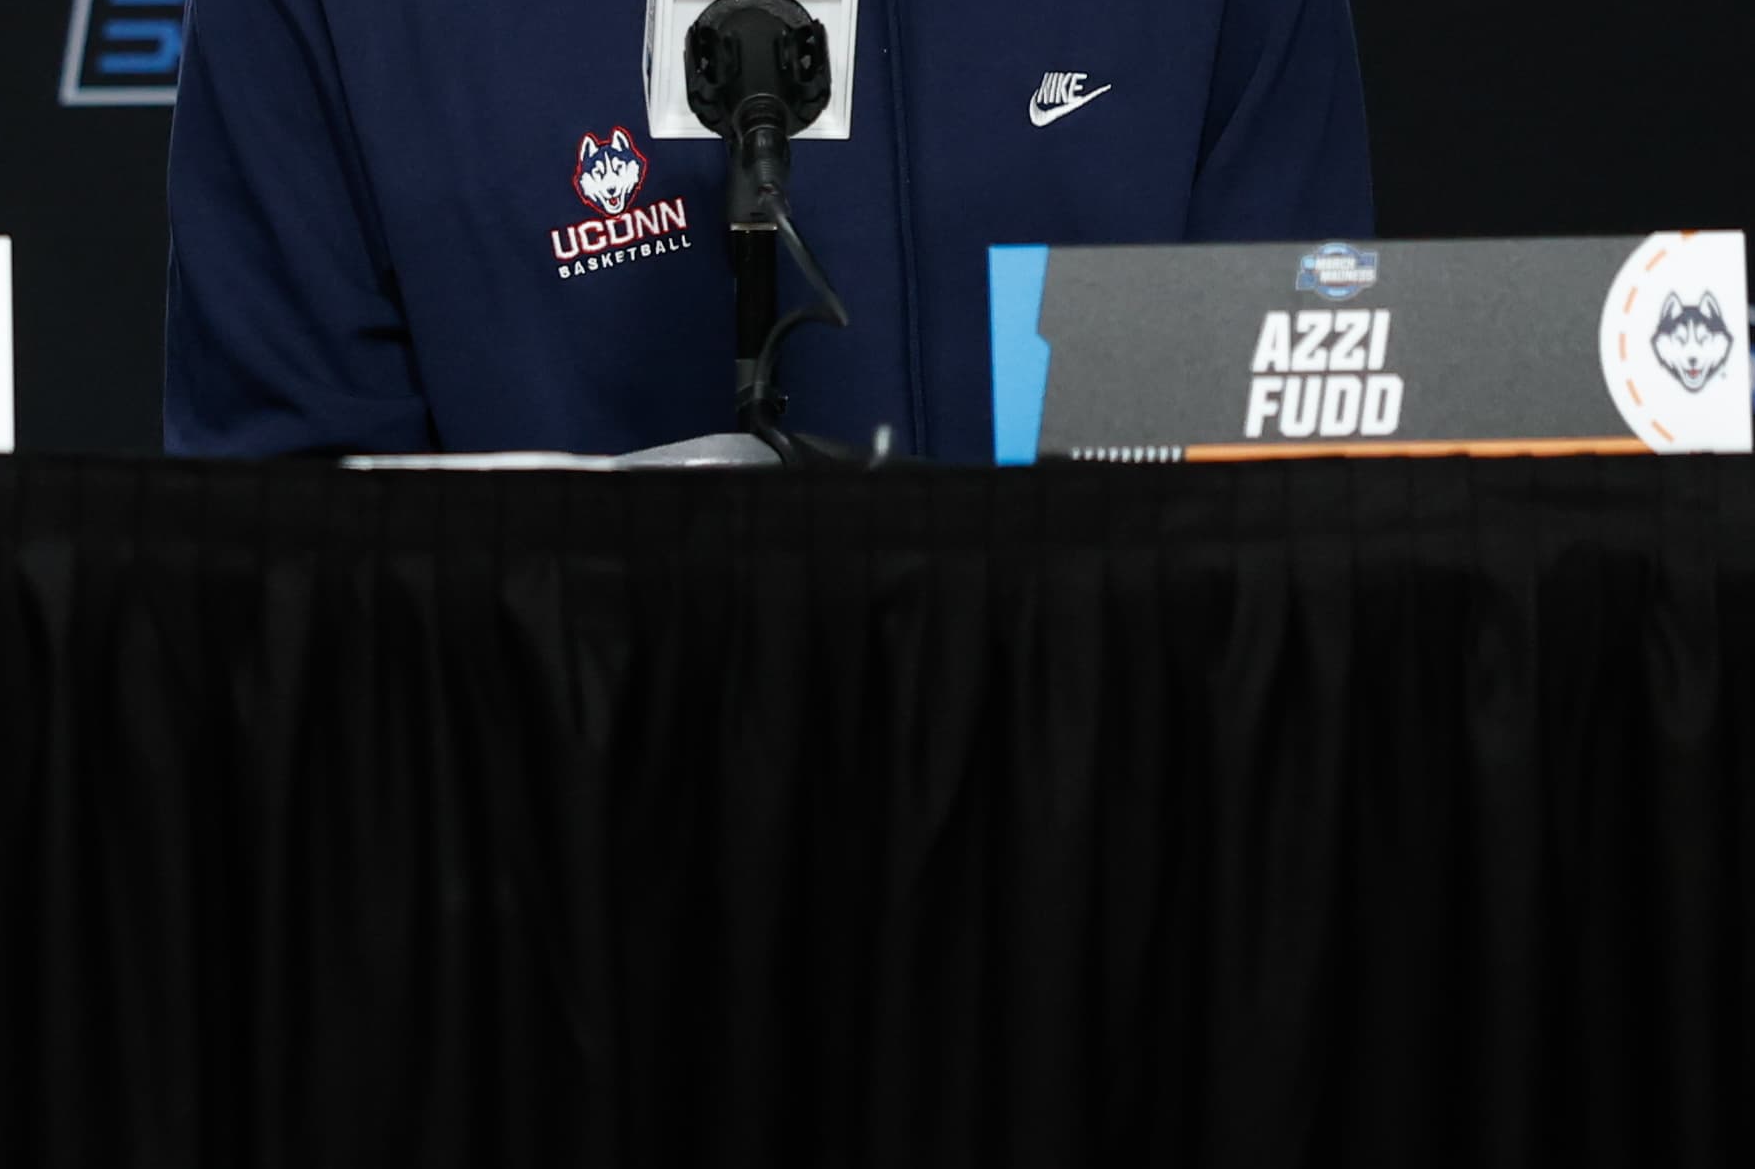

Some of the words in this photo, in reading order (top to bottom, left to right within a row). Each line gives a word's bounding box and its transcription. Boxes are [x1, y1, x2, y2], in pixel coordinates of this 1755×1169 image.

[1036, 71, 1088, 105] NIKE
[550, 197, 688, 260] UCONN
[557, 234, 692, 279] BASKETBALL
[1250, 309, 1392, 373] AZZI
[1244, 374, 1405, 438] FUDD
